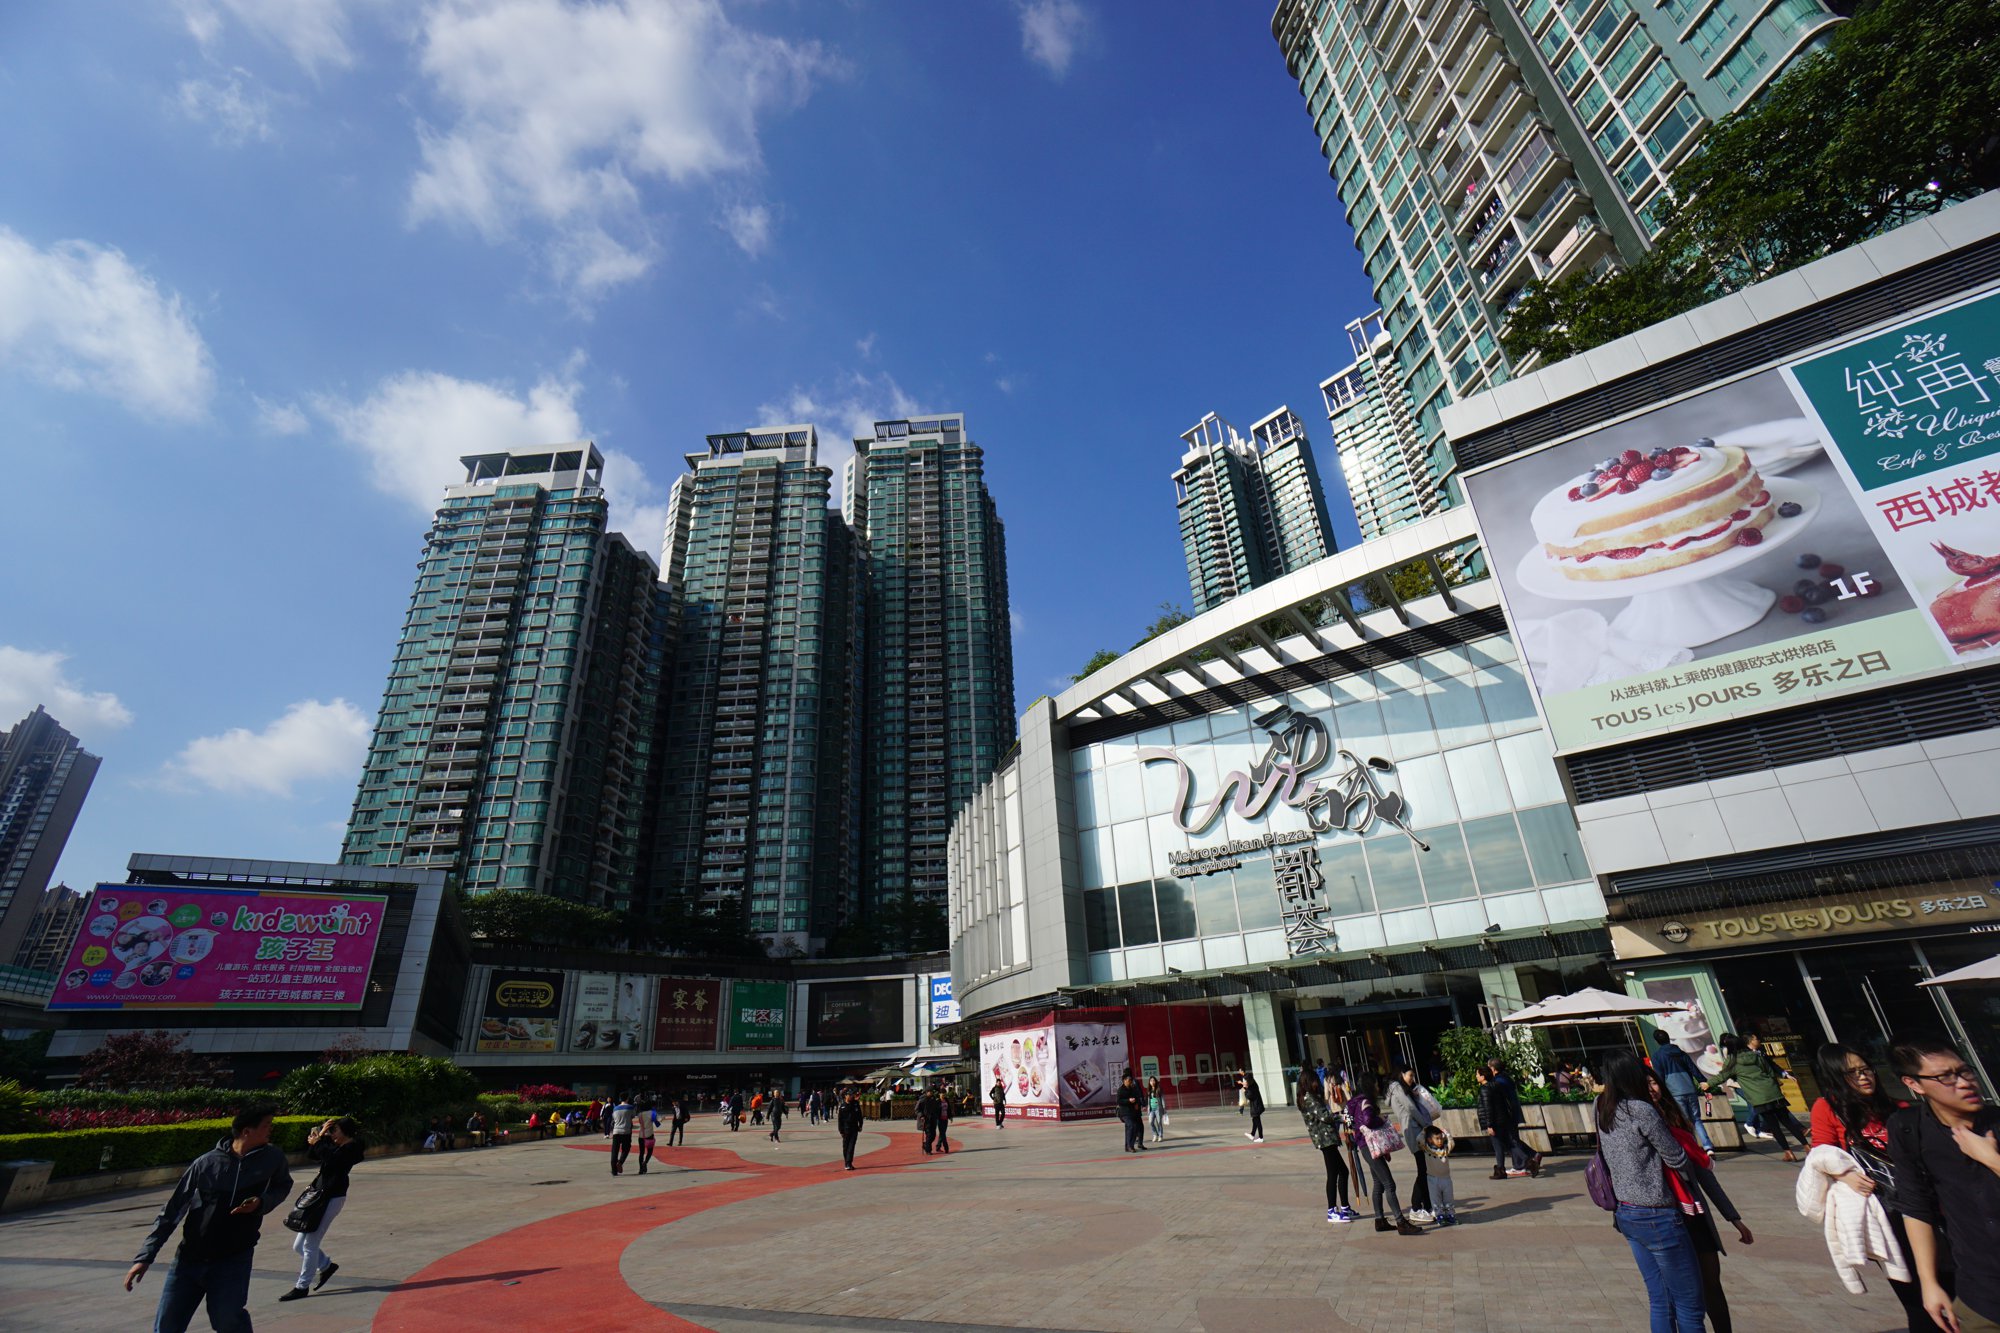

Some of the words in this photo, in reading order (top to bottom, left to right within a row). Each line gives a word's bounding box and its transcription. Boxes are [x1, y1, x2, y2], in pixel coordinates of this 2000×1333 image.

[1877, 449, 1927, 471] Cafe
[1933, 443, 1951, 461] &
[1830, 571, 1874, 600] 1F
[1610, 639, 1838, 703] 从选料就上乘的健康欧式烘焙店
[1772, 650, 1892, 695] 多乐之日
[1591, 706, 1652, 731] TOUS
[1655, 701, 1686, 718] les
[1688, 682, 1762, 714] JOURS
[1168, 836, 1264, 867] Metropolitan
[1262, 828, 1310, 852] Plaza
[1170, 856, 1240, 880] Guangzhou
[1273, 846, 1330, 954] 都荟
[1920, 895, 1988, 915] 多乐之日
[1705, 914, 1776, 941] TOUS
[1781, 909, 1819, 933] les
[1818, 898, 1914, 928] JOURS
[255, 936, 336, 961] 孩子王
[216, 963, 249, 972] 儿童游乐
[252, 963, 286, 973] 成长服务
[289, 964, 322, 974] 时尚购物
[325, 965, 363, 974] 全国连锁店
[237, 974, 338, 985] 一站式儿童主题MALL
[219, 989, 345, 1001] 孩子王位于西城都荟三楼
[671, 988, 709, 1012] 宴荟
